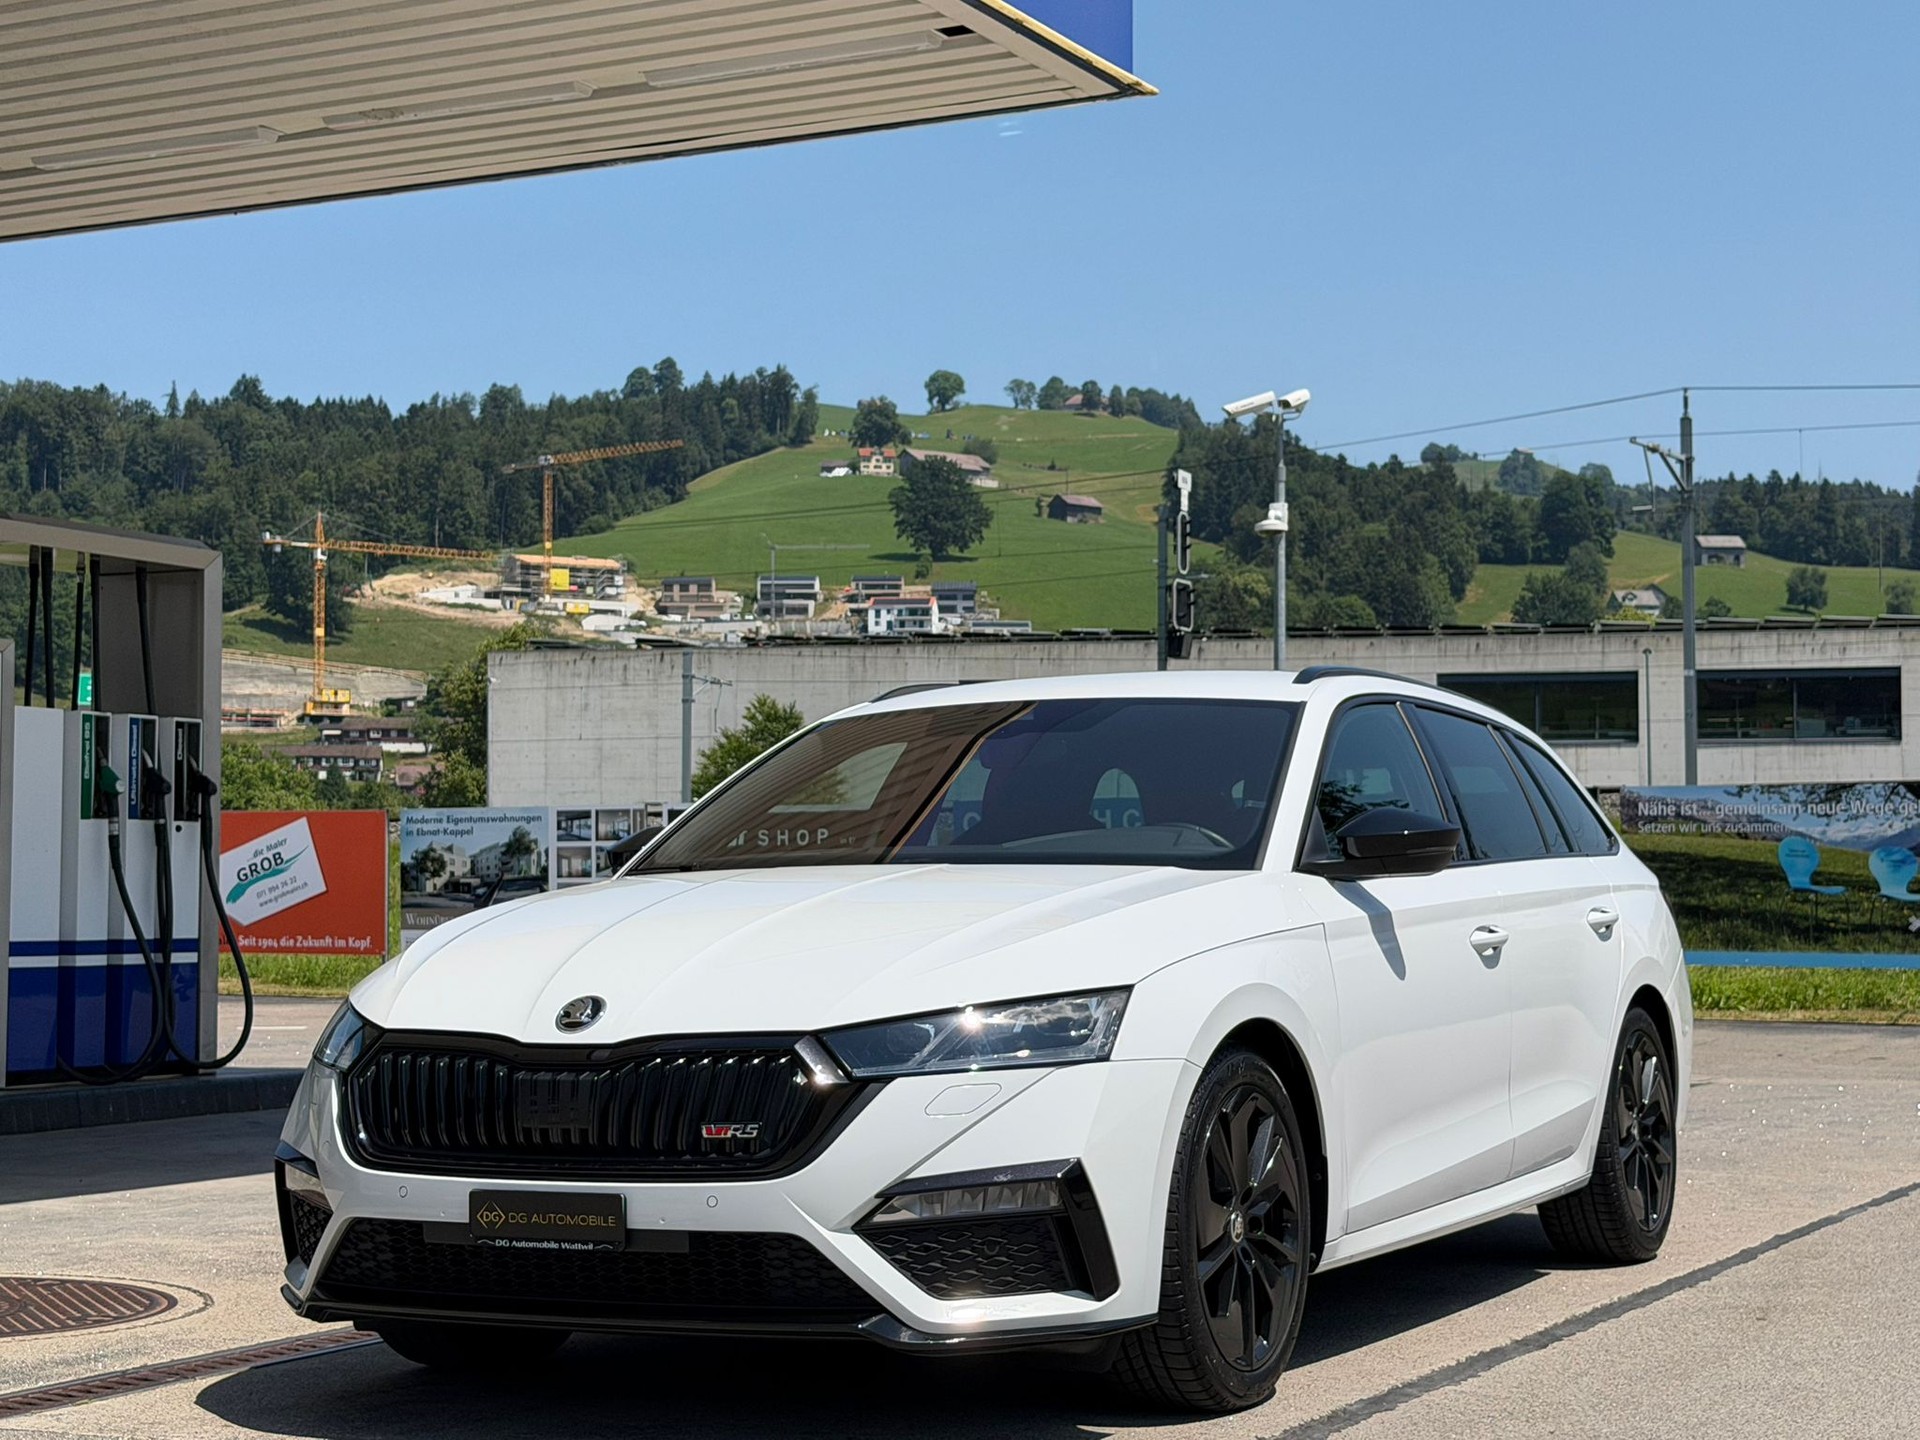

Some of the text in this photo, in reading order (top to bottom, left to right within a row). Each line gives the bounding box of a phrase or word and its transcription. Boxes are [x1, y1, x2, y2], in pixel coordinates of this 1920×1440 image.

[1637, 800, 1676, 816] Nähe
[1715, 802, 1800, 818] gemeinsam
[1807, 802, 1845, 815] neue
[1850, 800, 1894, 817] Wege
[1898, 799, 1920, 817] ge
[405, 813, 542, 826] Moderne Eigentumswohnungen
[1637, 820, 1675, 833] Setzen
[1679, 820, 1697, 833] wir
[1700, 821, 1721, 833] uns
[405, 826, 474, 838] in Ebnat-Kappel
[757, 828, 829, 846] SHOP
[266, 838, 287, 853] Maler
[236, 851, 284, 882] GROB
[239, 935, 256, 947] Seit
[257, 937, 278, 950] 1904
[280, 935, 295, 947] die
[296, 935, 333, 948] Zukunft
[334, 936, 347, 948] im
[348, 936, 372, 951] Kopf.
[483, 1211, 617, 1227] DG DG AUTOMOBILE
[495, 1239, 594, 1250] DG Automobile Wattwil
